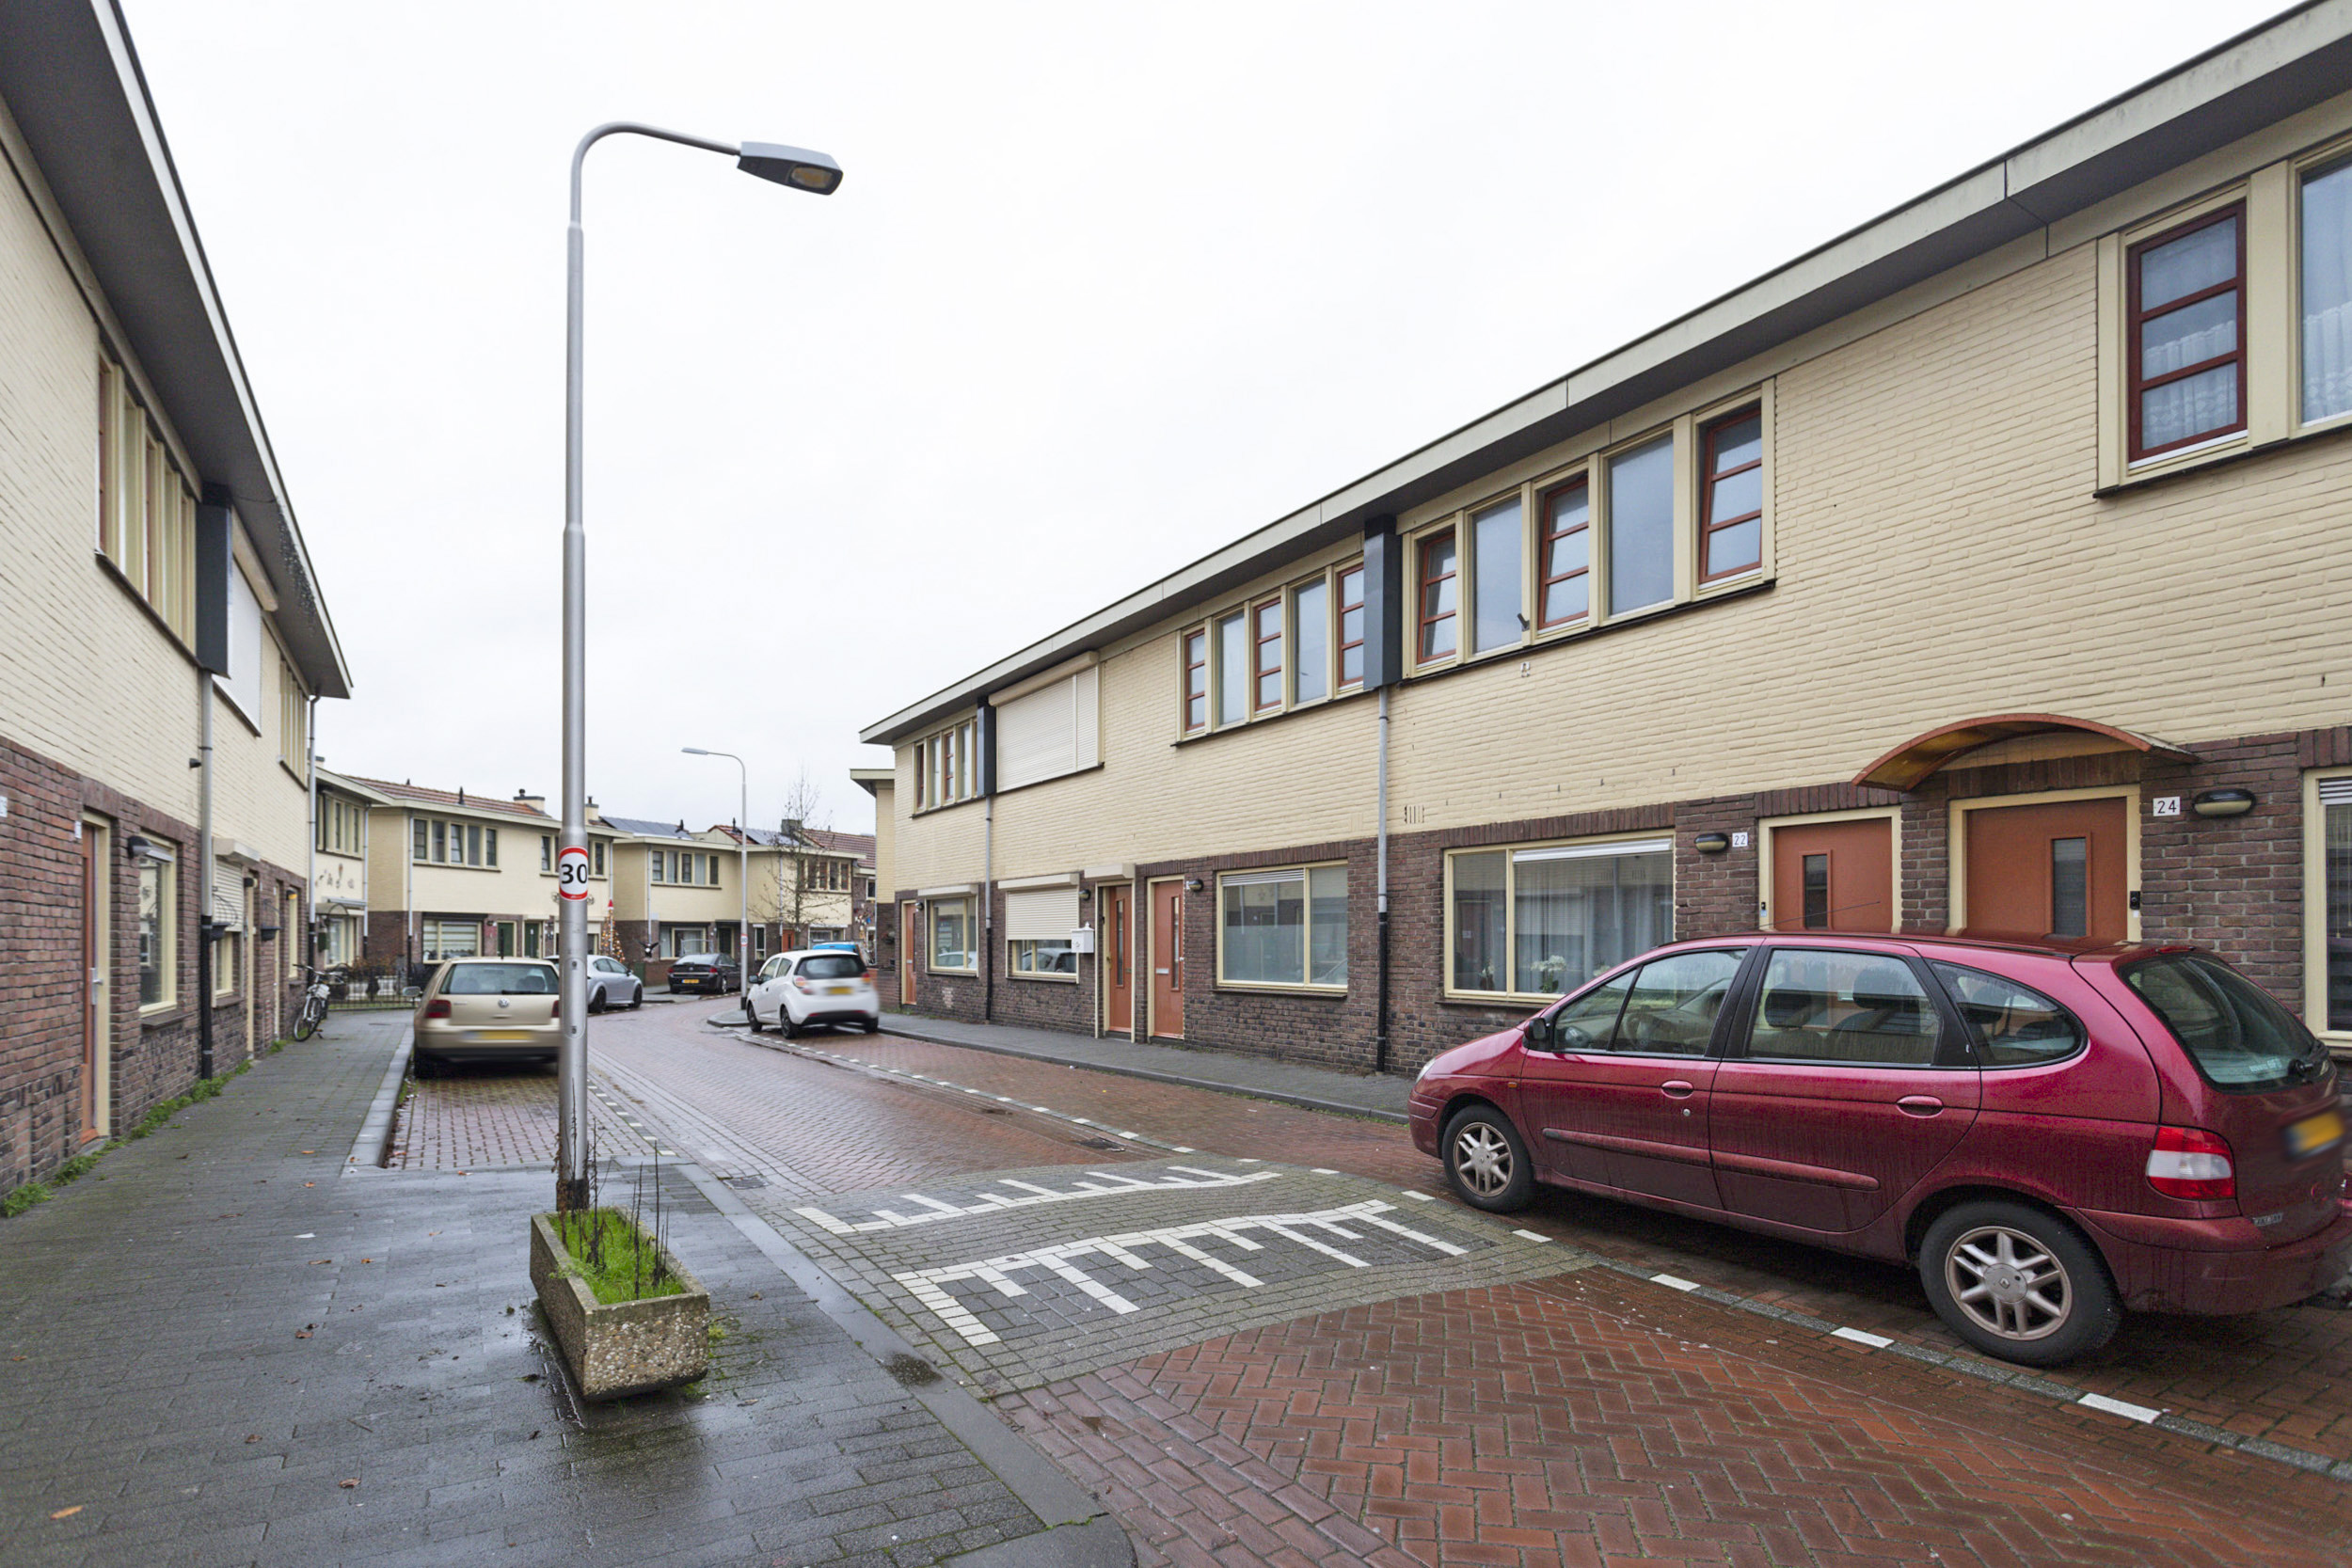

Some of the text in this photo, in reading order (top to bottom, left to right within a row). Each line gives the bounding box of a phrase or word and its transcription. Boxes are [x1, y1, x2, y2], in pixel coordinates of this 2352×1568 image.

[2157, 800, 2177, 814] 24
[1734, 834, 1746, 846] 22
[561, 863, 588, 884] 30
